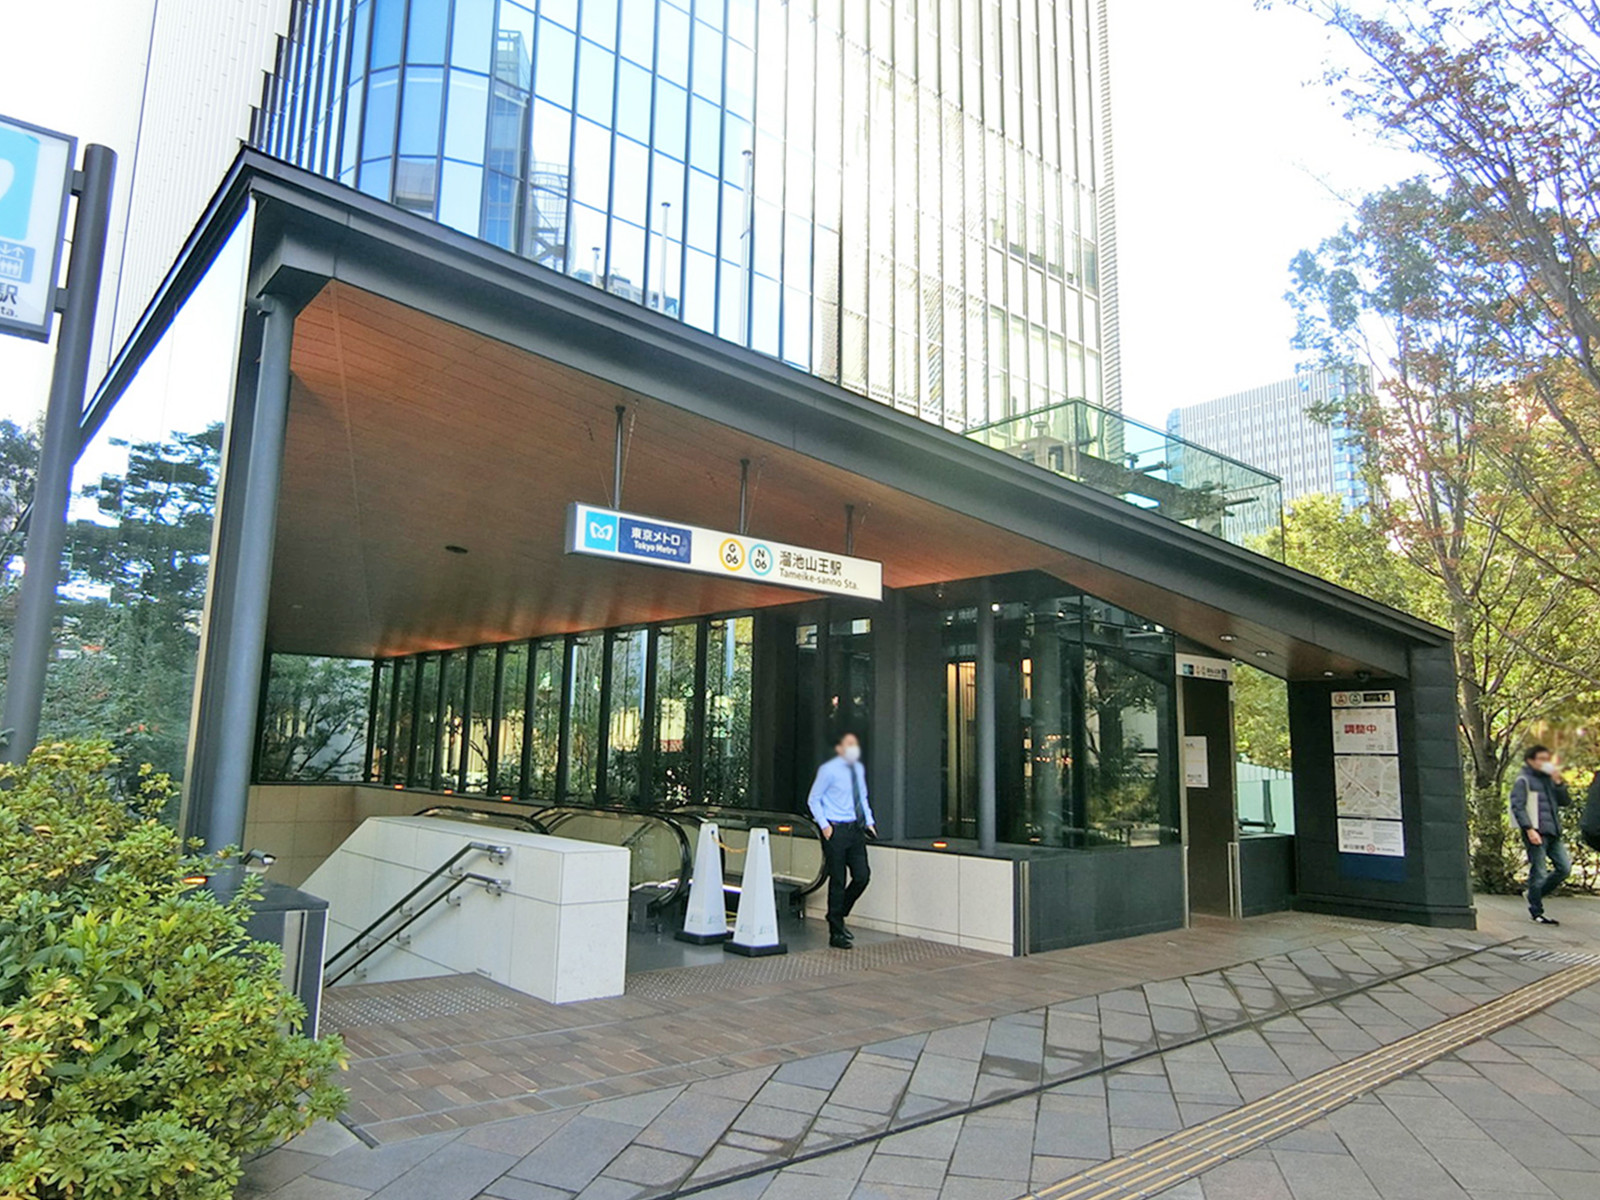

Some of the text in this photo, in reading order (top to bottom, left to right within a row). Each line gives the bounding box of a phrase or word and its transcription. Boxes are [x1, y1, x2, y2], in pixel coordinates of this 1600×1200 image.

[631, 526, 681, 546] 東京メトロ
[633, 540, 678, 556] Tokyo Metro
[728, 543, 736, 553] G
[757, 549, 765, 559] N
[725, 553, 739, 565] 06
[754, 558, 768, 570] 06
[779, 550, 843, 576] 溜池山王駅
[779, 567, 859, 590] Tameike-sanno Sta.
[1344, 724, 1376, 734] 調整中
